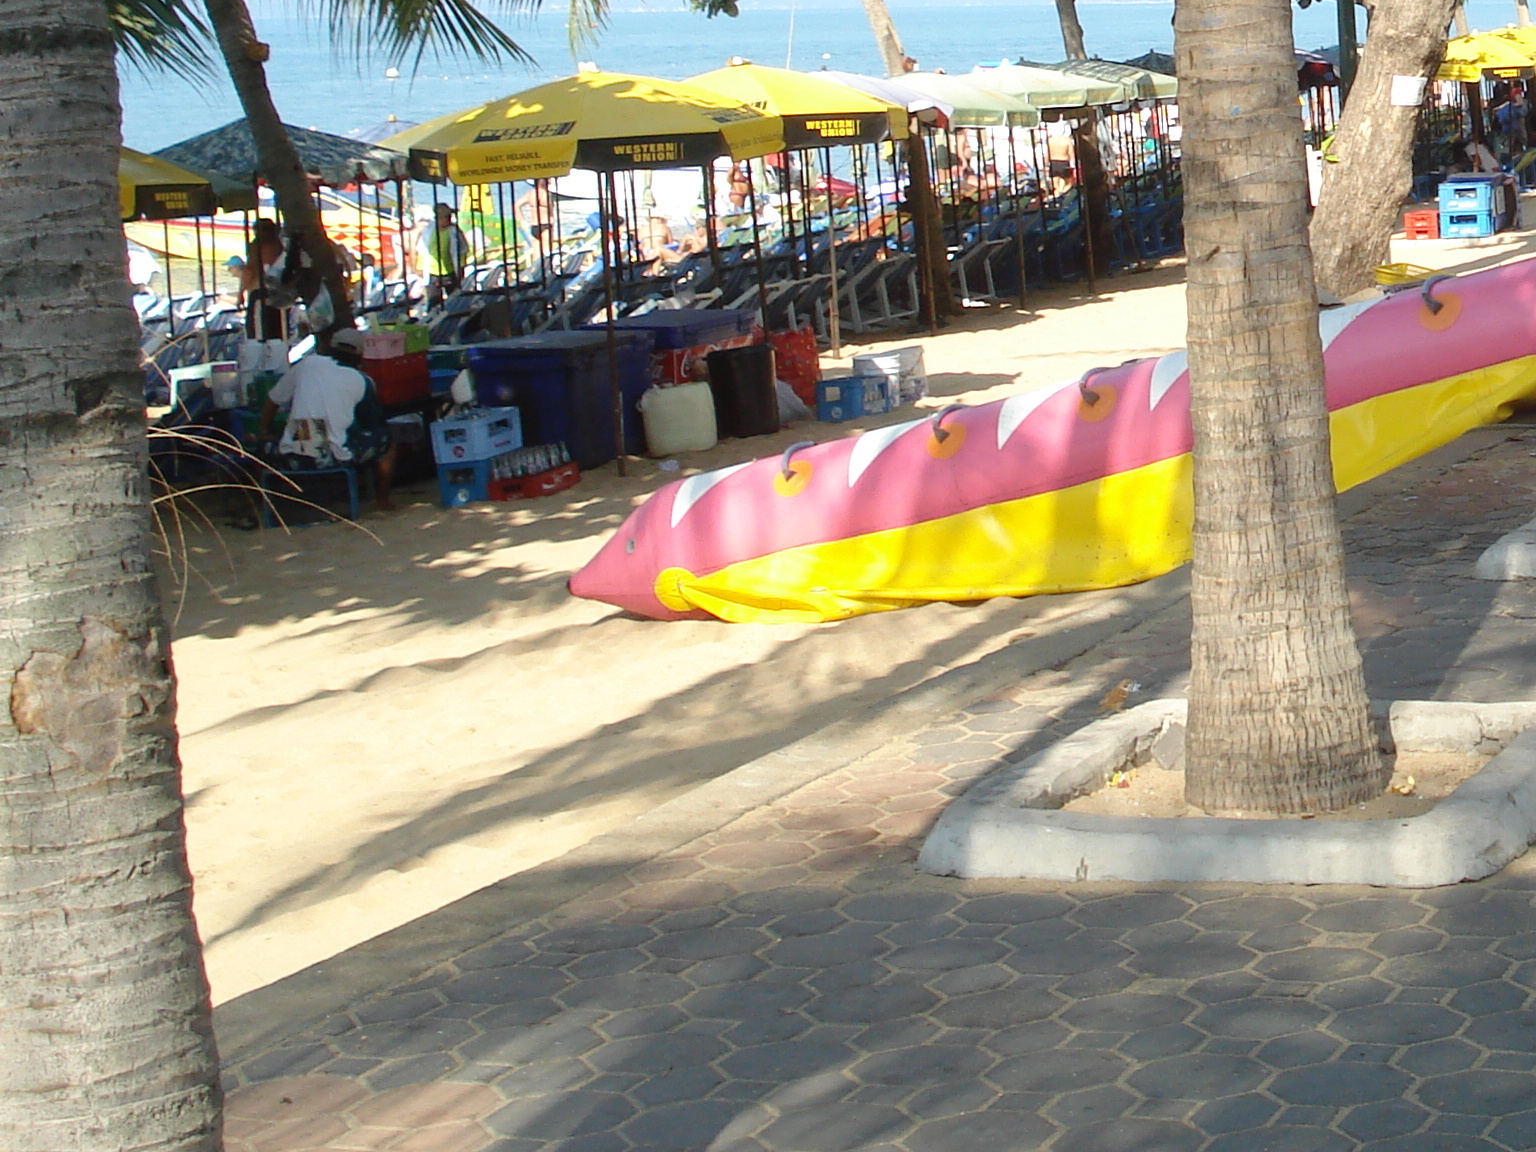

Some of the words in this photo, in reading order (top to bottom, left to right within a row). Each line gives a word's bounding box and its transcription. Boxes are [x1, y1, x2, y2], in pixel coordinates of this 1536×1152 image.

[805, 119, 853, 130] WESTERN
[820, 128, 855, 137] UNION
[613, 142, 675, 155] WESTERN
[633, 152, 675, 163] UNION
[505, 165, 531, 173] MONEY
